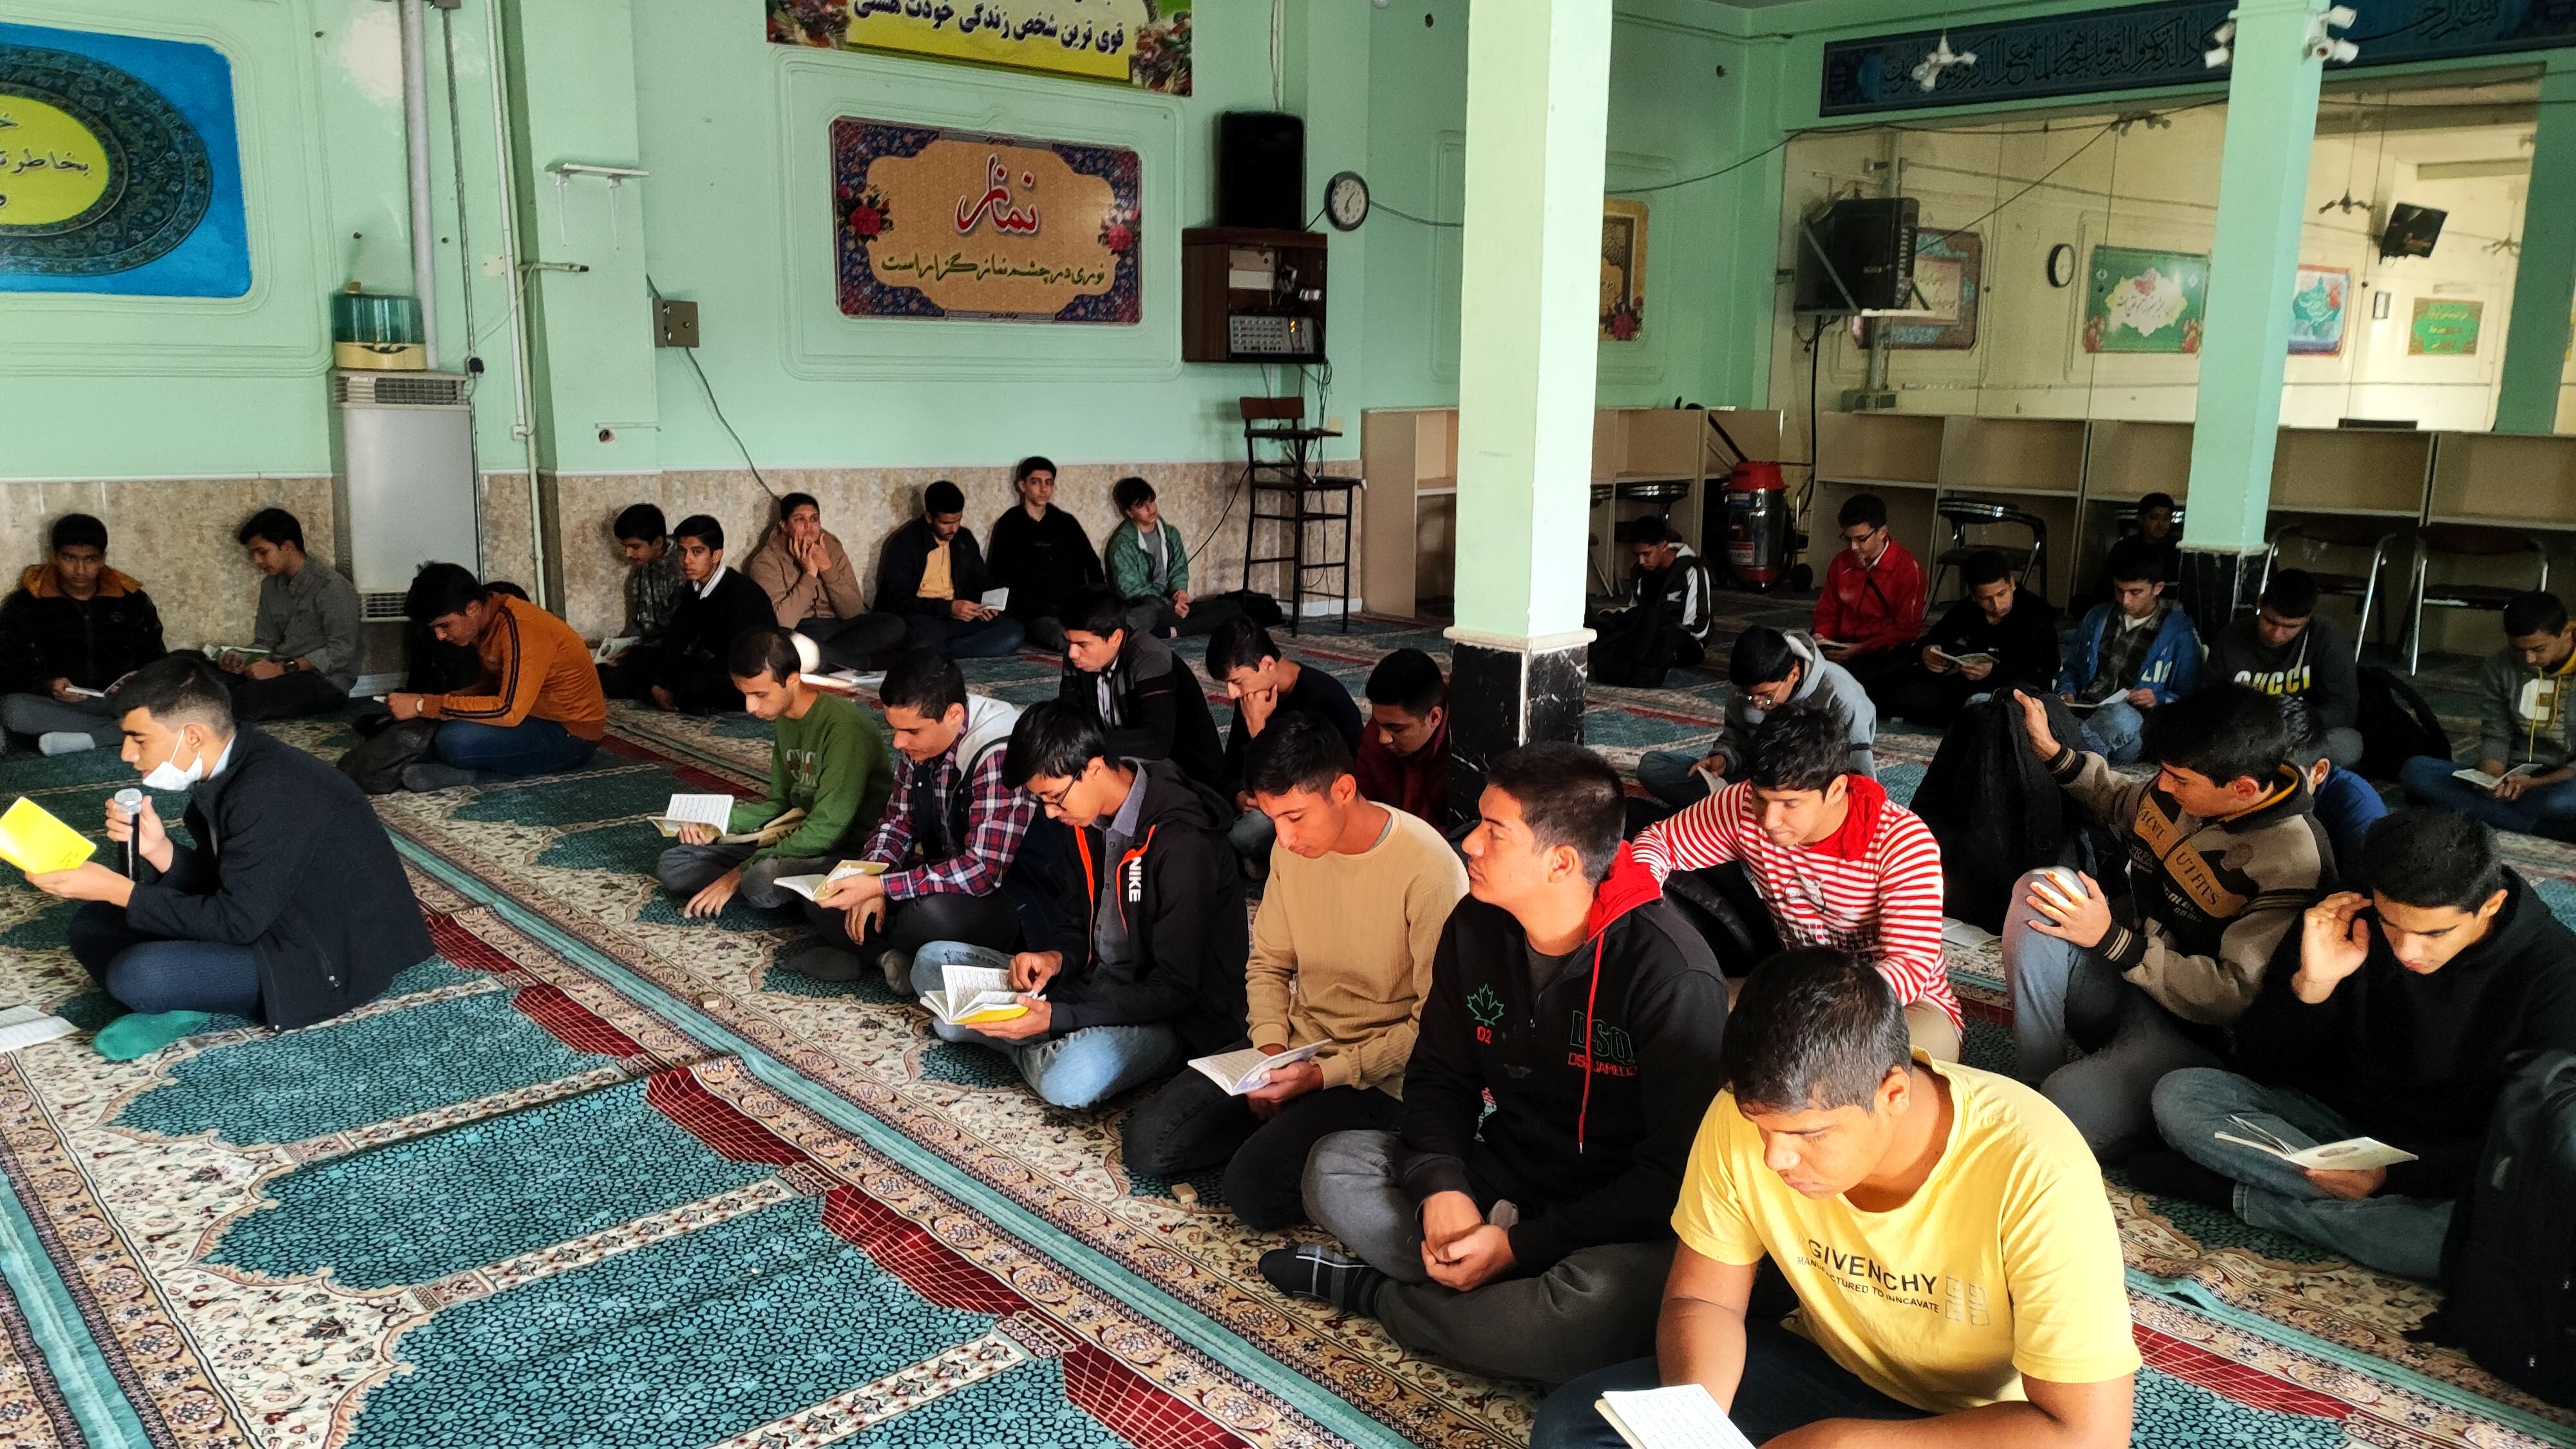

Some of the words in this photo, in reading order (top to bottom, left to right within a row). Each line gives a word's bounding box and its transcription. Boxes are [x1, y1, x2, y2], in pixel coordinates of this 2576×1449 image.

[905, 0, 954, 30] خودت
[958, 2, 1010, 40] زندگی
[1012, 11, 1058, 41] شخص
[1061, 19, 1093, 51] ترین
[1095, 21, 1124, 55] قوی
[10, 149, 89, 177] بخاطر
[954, 153, 1039, 233] نماز
[1050, 267, 1071, 284] در
[1072, 263, 1104, 285] نوری
[1128, 857, 1142, 902] NIKE
[1808, 1238, 1938, 1295] GIVENCHY
[1871, 1285, 1884, 1298] TO
